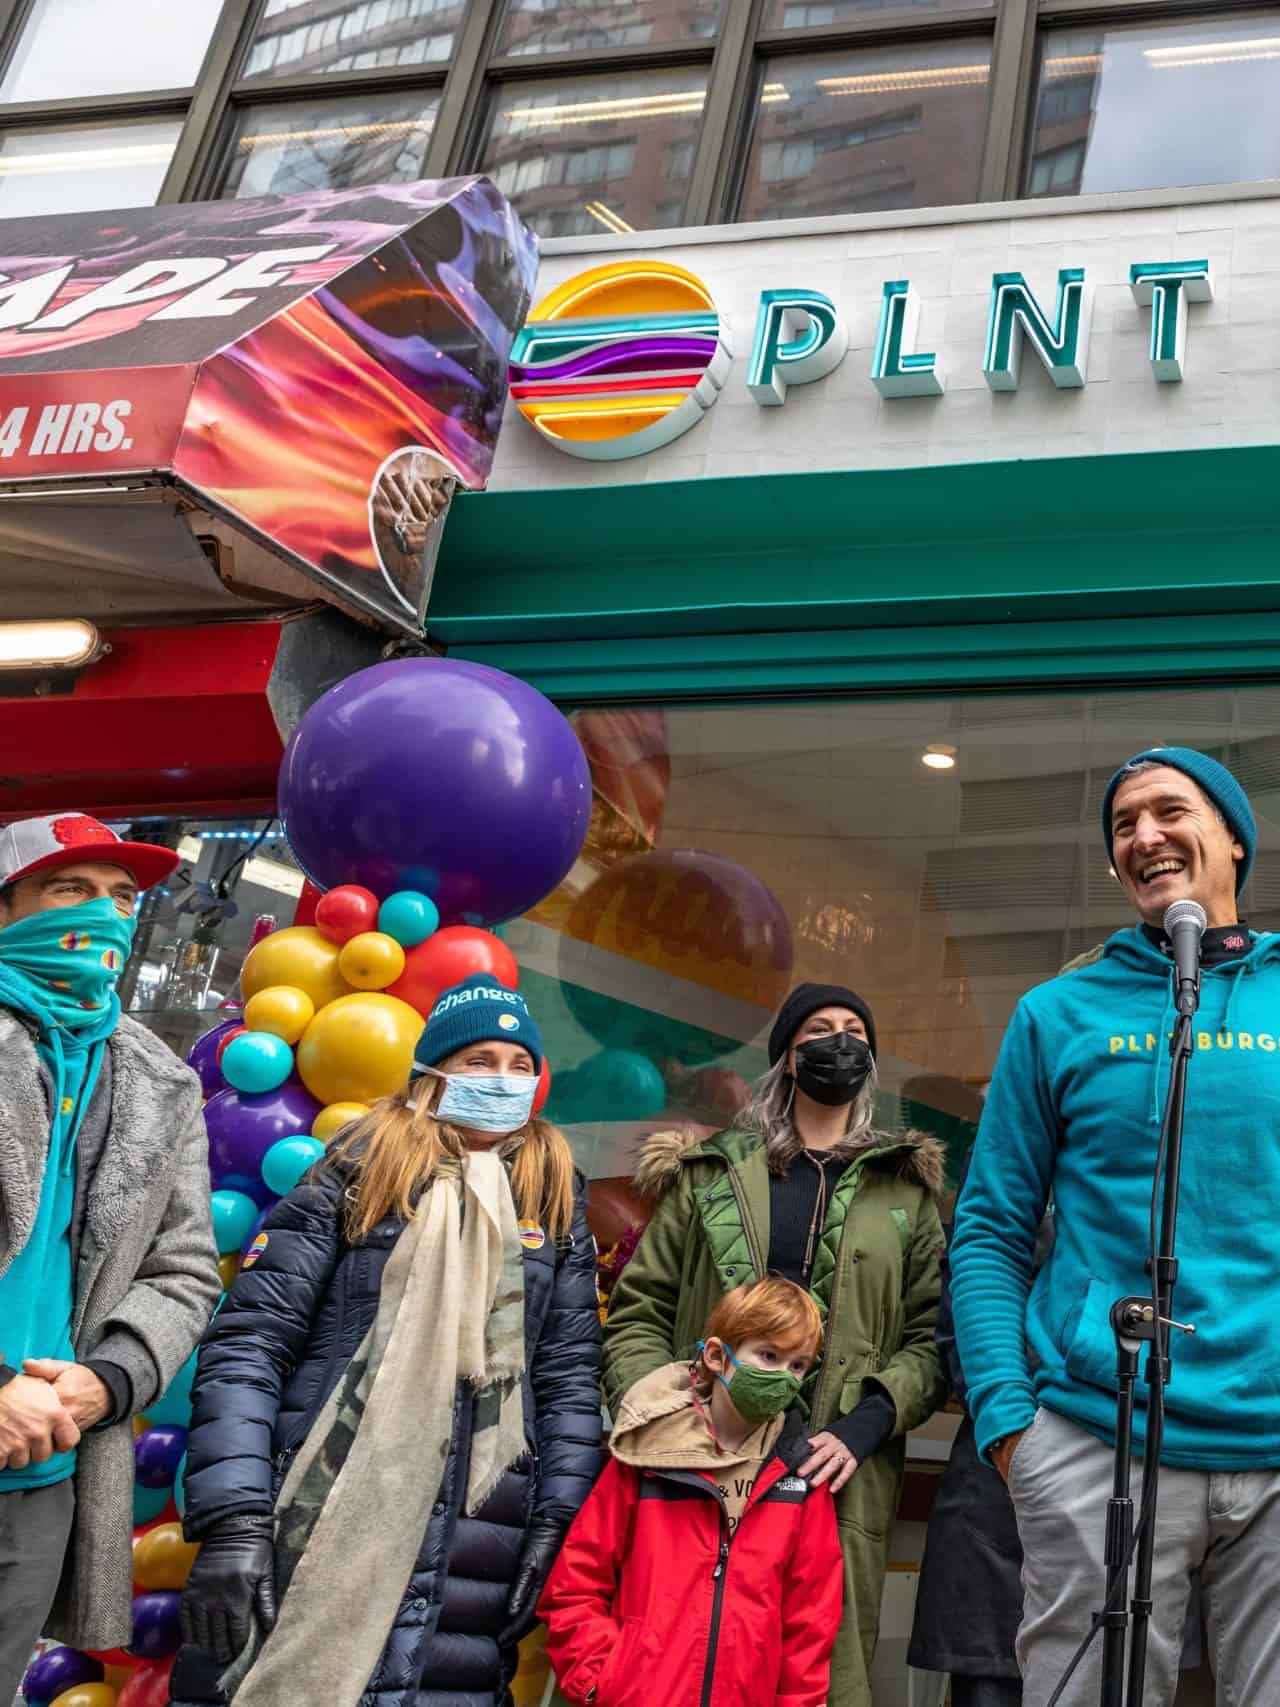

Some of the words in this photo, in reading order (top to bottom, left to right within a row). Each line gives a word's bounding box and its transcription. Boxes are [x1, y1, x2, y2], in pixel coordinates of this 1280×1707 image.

[0, 243, 339, 332] APE
[746, 259, 1214, 405] PLNT
[28, 400, 134, 457] HRS.
[1109, 1032, 1174, 1054] PLN
